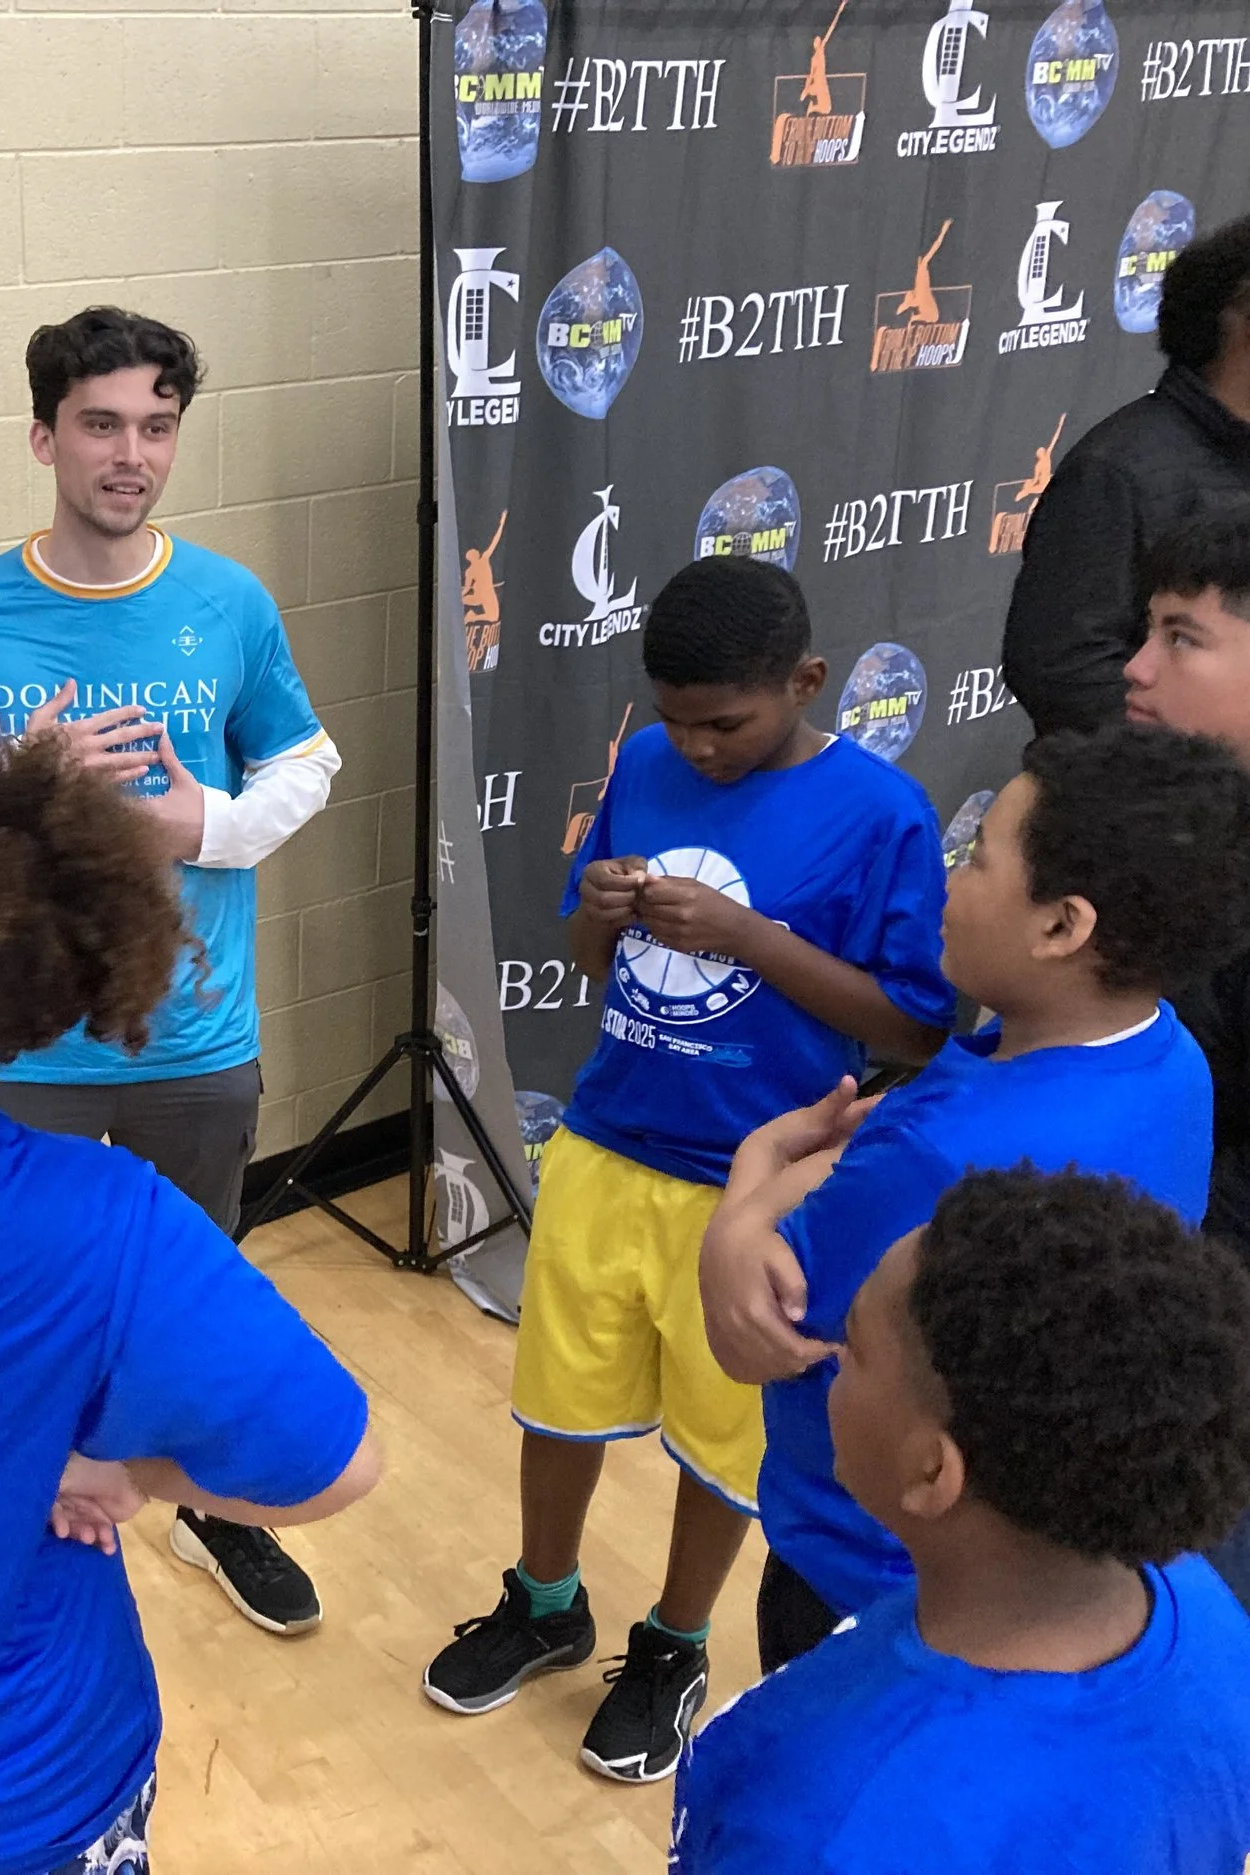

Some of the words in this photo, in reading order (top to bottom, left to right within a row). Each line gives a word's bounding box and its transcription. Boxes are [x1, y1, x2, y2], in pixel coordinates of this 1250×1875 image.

[897, 131, 932, 157] CITY
[931, 126, 997, 154] EGENDZ
[679, 284, 848, 363] #B2TTH
[999, 328, 1021, 355] CITY
[1019, 319, 1087, 350] LEGENDZ
[916, 343, 956, 367] HOOPS
[823, 480, 973, 563] #B2TTH
[539, 622, 590, 647] CITY
[709, 950, 735, 964] HUB
[627, 1019, 656, 1049] 2025
